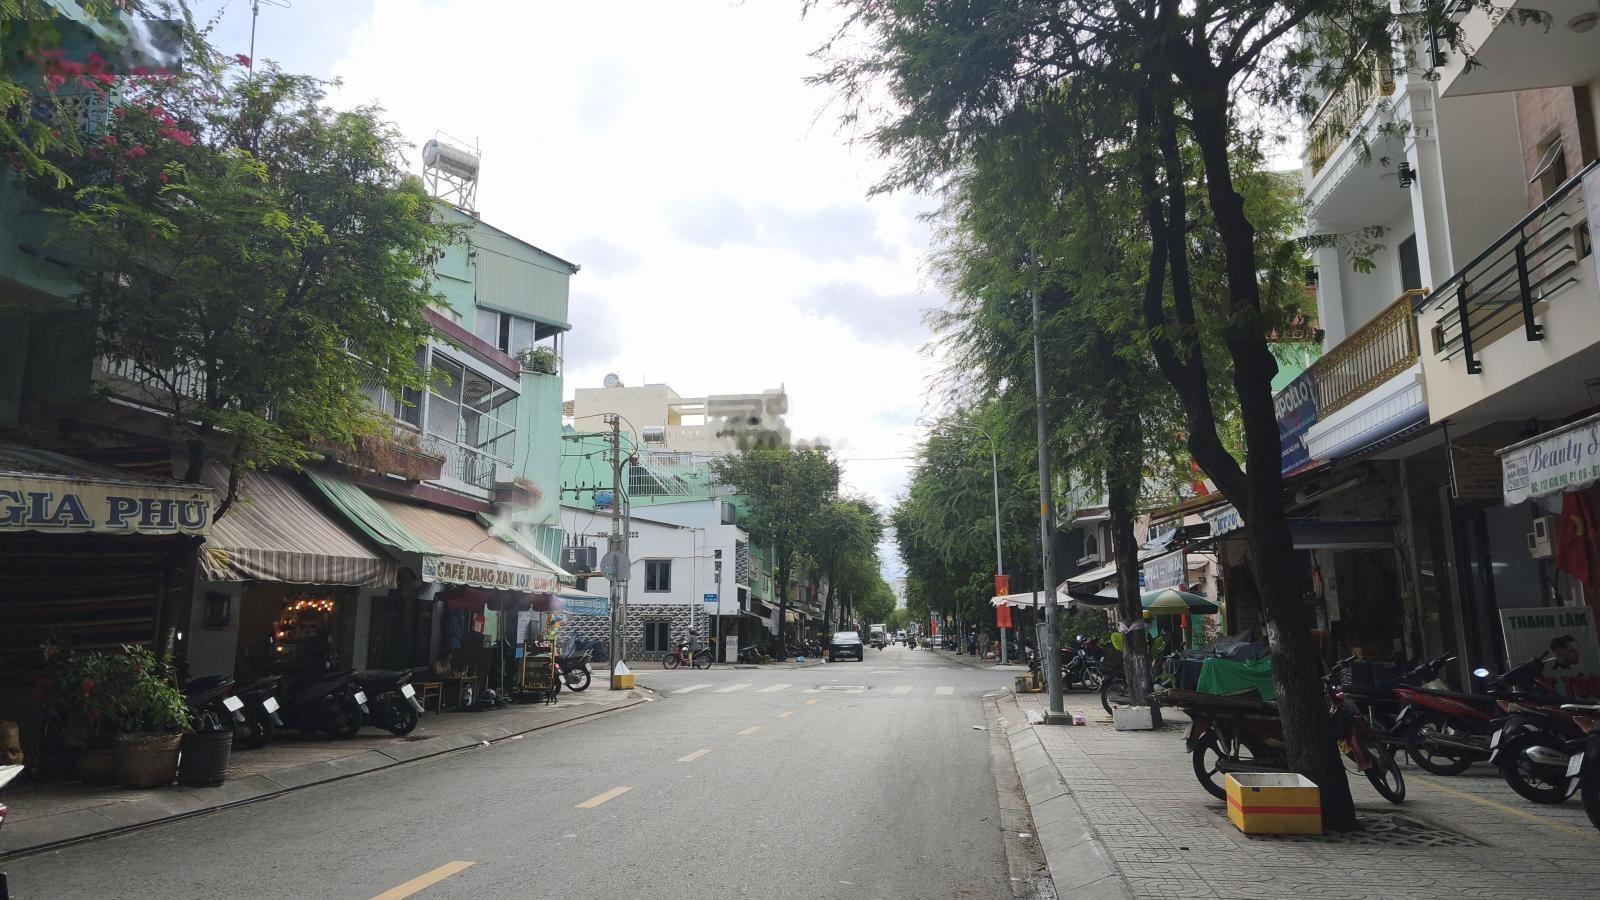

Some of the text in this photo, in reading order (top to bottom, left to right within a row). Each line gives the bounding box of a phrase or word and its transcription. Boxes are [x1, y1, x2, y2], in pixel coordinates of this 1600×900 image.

[1528, 438, 1582, 473] Beauty
[0, 489, 209, 531] GIA PHÚ
[437, 561, 465, 581] CAFÉ
[466, 566, 494, 585] RANG
[495, 570, 514, 586] XAY
[1508, 611, 1588, 630] THANH LÂM
